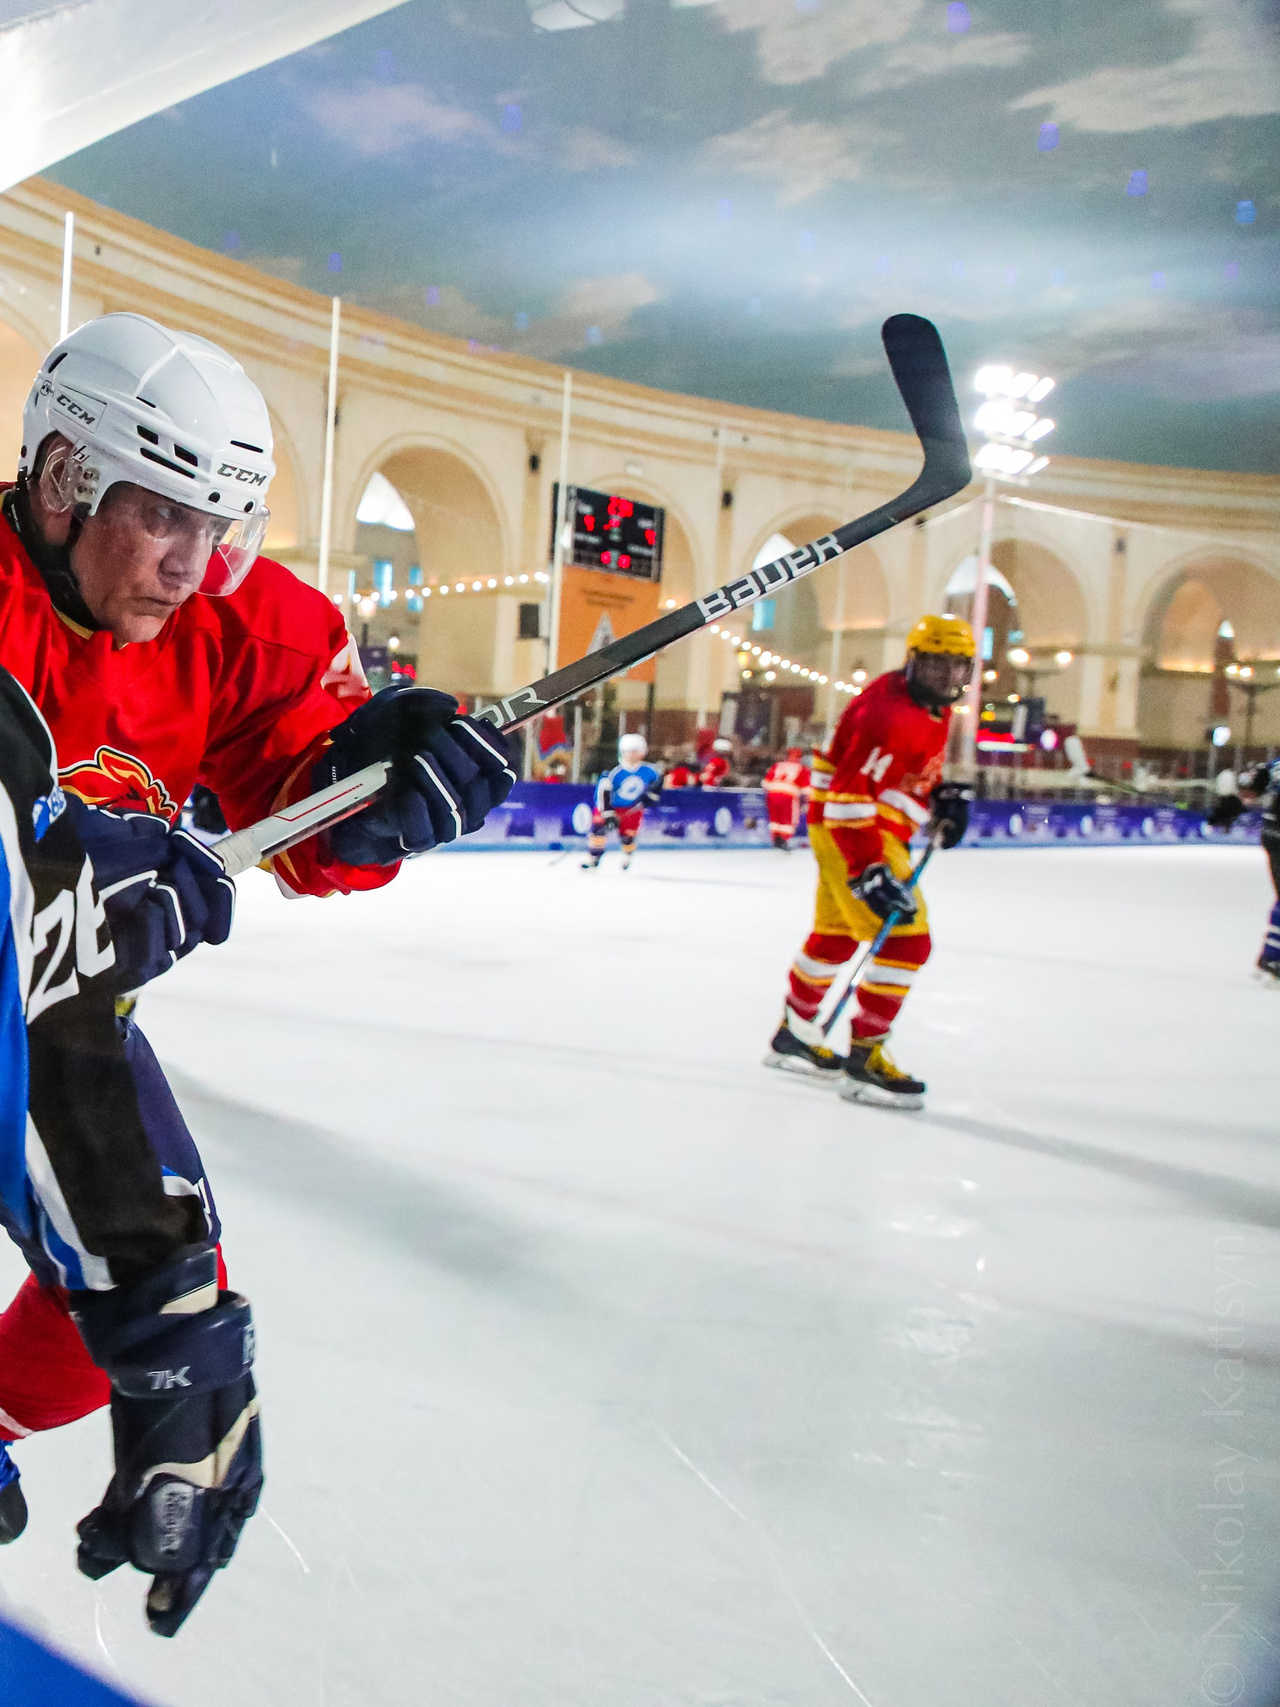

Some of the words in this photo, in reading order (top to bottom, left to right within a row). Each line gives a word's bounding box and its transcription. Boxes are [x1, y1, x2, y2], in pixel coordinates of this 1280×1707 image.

[56, 394, 96, 425] CCM
[217, 462, 267, 486] CCM
[695, 532, 844, 623] BAUER
[859, 746, 894, 783] 14
